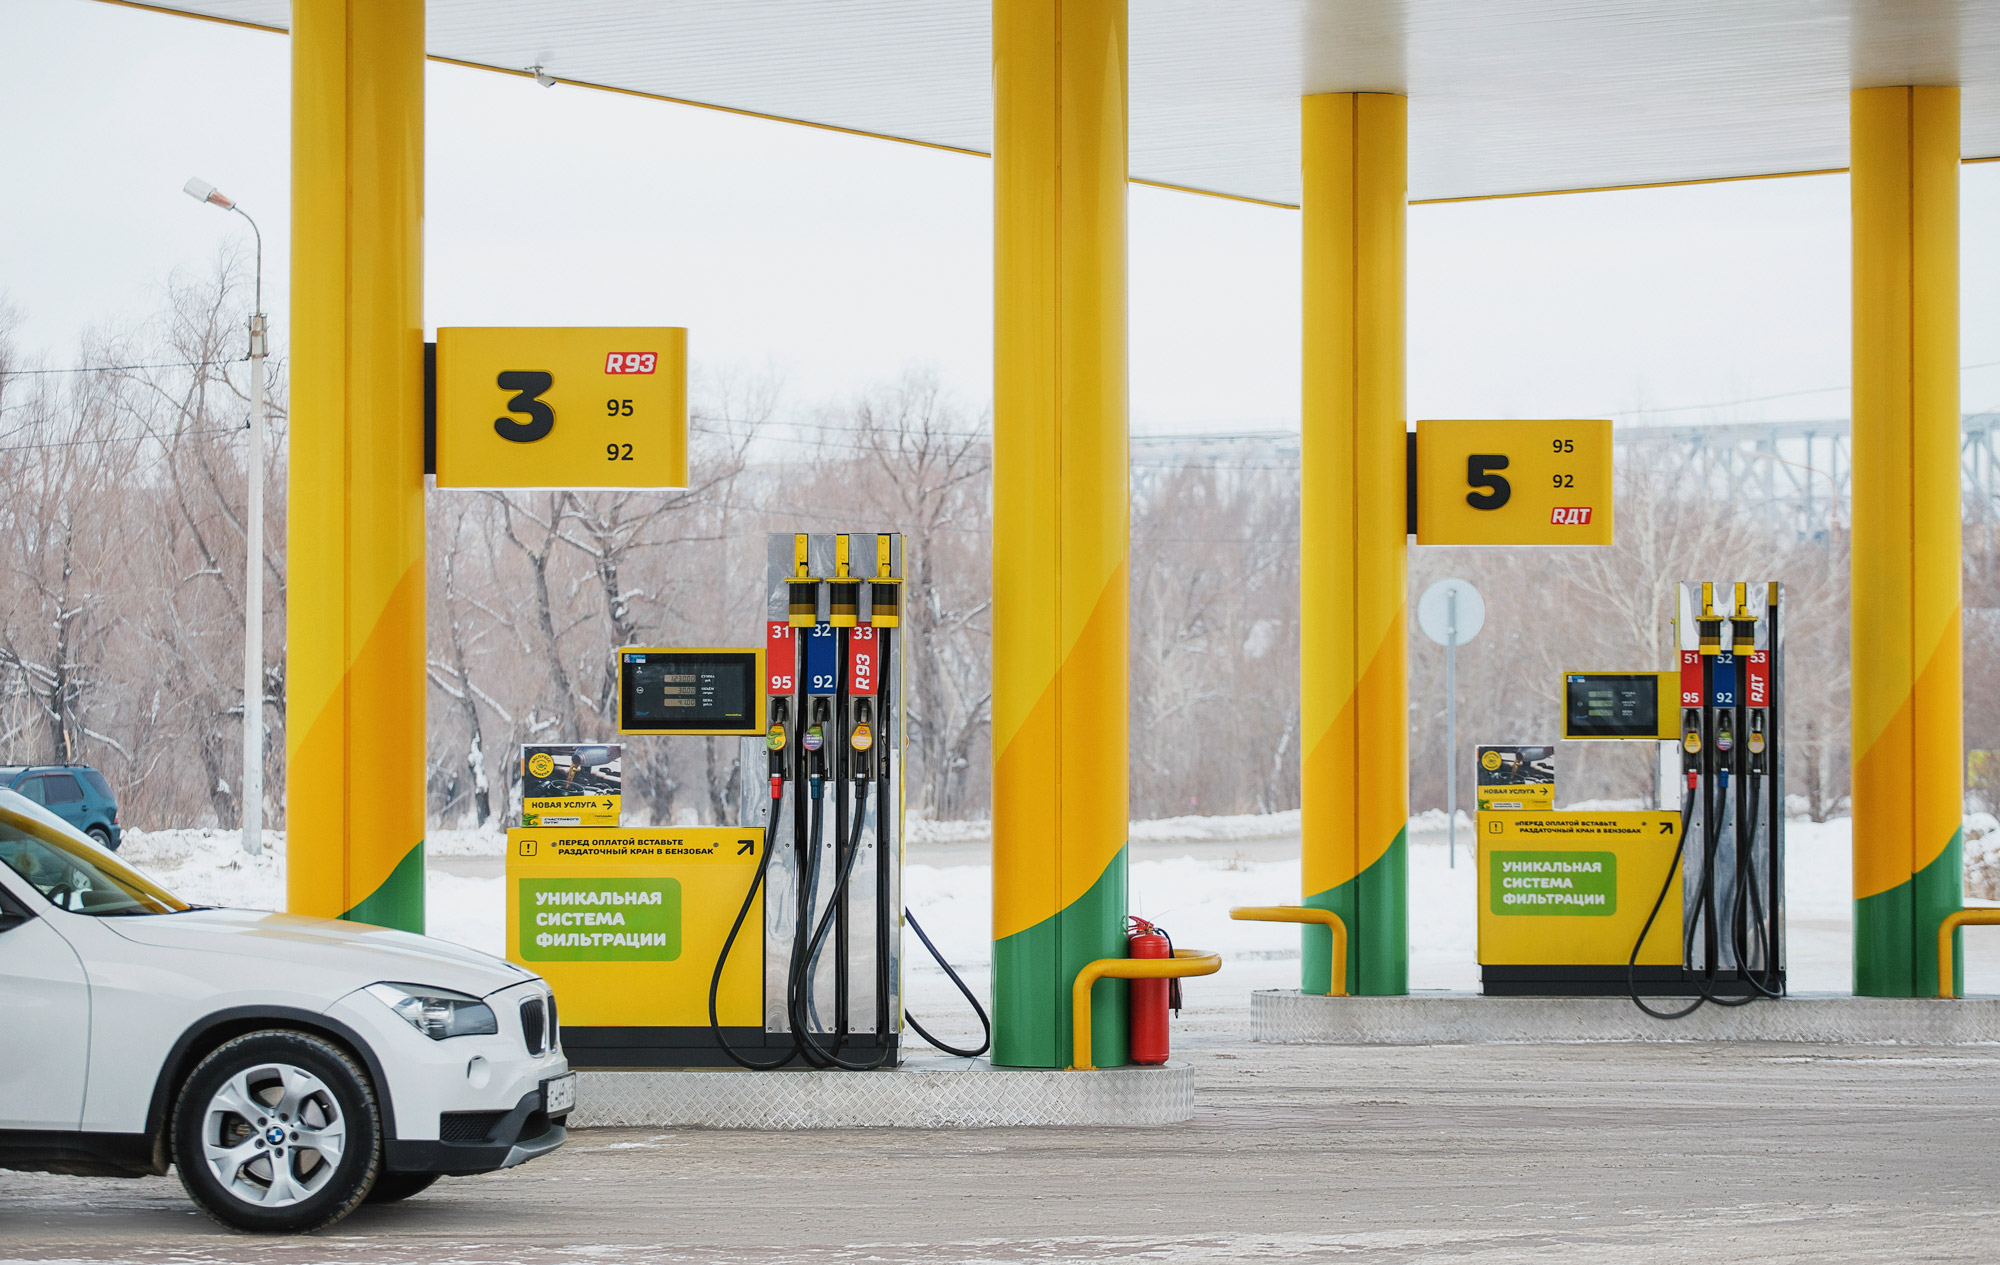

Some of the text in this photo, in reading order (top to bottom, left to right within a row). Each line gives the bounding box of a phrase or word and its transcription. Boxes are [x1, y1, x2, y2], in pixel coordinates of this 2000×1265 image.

[494, 370, 555, 443] 3
[606, 399, 634, 417] 95
[606, 443, 634, 461] 92
[1552, 439, 1574, 453] 95
[1466, 454, 1511, 510] 5
[1552, 474, 1574, 488] 92
[772, 625, 790, 639] 31
[812, 624, 832, 637] 32
[853, 626, 873, 640] 33
[1684, 653, 1698, 664] 51
[1717, 653, 1733, 664] 52
[1750, 652, 1766, 663] 53
[771, 675, 792, 689] 95
[813, 674, 834, 688] 92
[1682, 692, 1699, 703] 95
[1716, 692, 1733, 703] 92
[531, 801, 597, 809] НОВАЯ УСЛУГА
[558, 839, 590, 847] ПЕРЕД
[591, 837, 635, 846] ОПЛАТОЙ
[558, 846, 628, 856] РАЗДАТОЧНЫЙ
[1502, 861, 1602, 873] УНИКАЛЬНАЯ
[1502, 877, 1573, 889] СИСТЕМА
[535, 891, 662, 906] УНИКАЛЬНАЯ
[1502, 893, 1606, 907] ФИЛЬТРАЦИИ
[535, 912, 626, 926] СИСТЕМА
[535, 932, 667, 949] ФИЛЬТРАЦИИ
